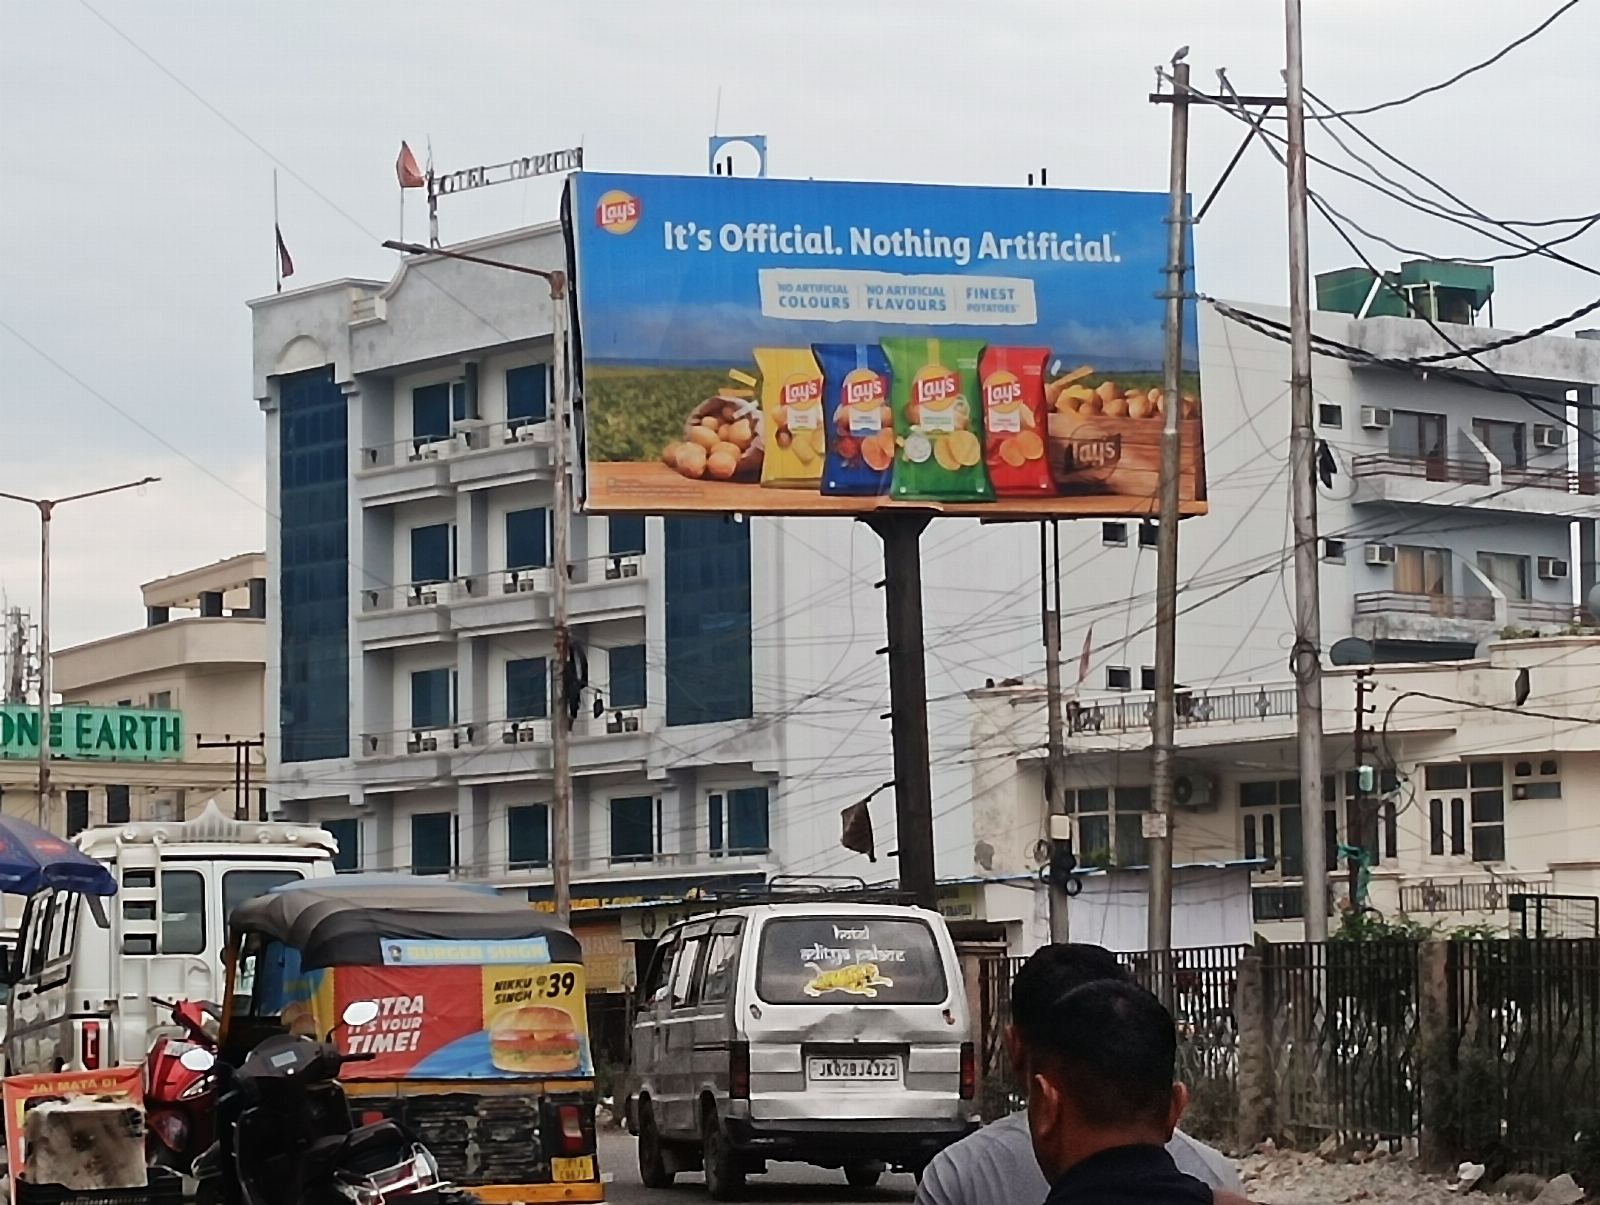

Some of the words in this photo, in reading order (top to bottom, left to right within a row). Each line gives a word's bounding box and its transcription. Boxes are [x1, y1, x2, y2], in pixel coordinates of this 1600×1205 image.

[601, 200, 636, 225] Lay's
[664, 221, 712, 251] It's
[719, 223, 843, 255] Official.
[850, 227, 970, 265] Nothing
[977, 231, 1121, 263] Artificial.
[778, 283, 793, 293] NO
[796, 284, 848, 294] ARTIFICIAL
[866, 285, 883, 296] NO
[886, 286, 946, 297] ARTIFICIAL
[966, 287, 1015, 300] FINEST
[779, 296, 850, 308] COLOURS
[867, 298, 947, 311] FLAVOURS
[785, 379, 818, 404] Lay's
[847, 378, 883, 404] Lay's
[917, 376, 955, 402] Lay's
[987, 381, 1021, 406] Lay's
[76, 713, 181, 752] EARTH
[494, 977, 533, 992] NIKKU
[494, 990, 533, 1004] SINGH
[381, 1016, 422, 1031] YOUR
[347, 1030, 421, 1055] TIME!
[58, 1079, 97, 1091] MATA
[101, 1078, 117, 1088] DI
